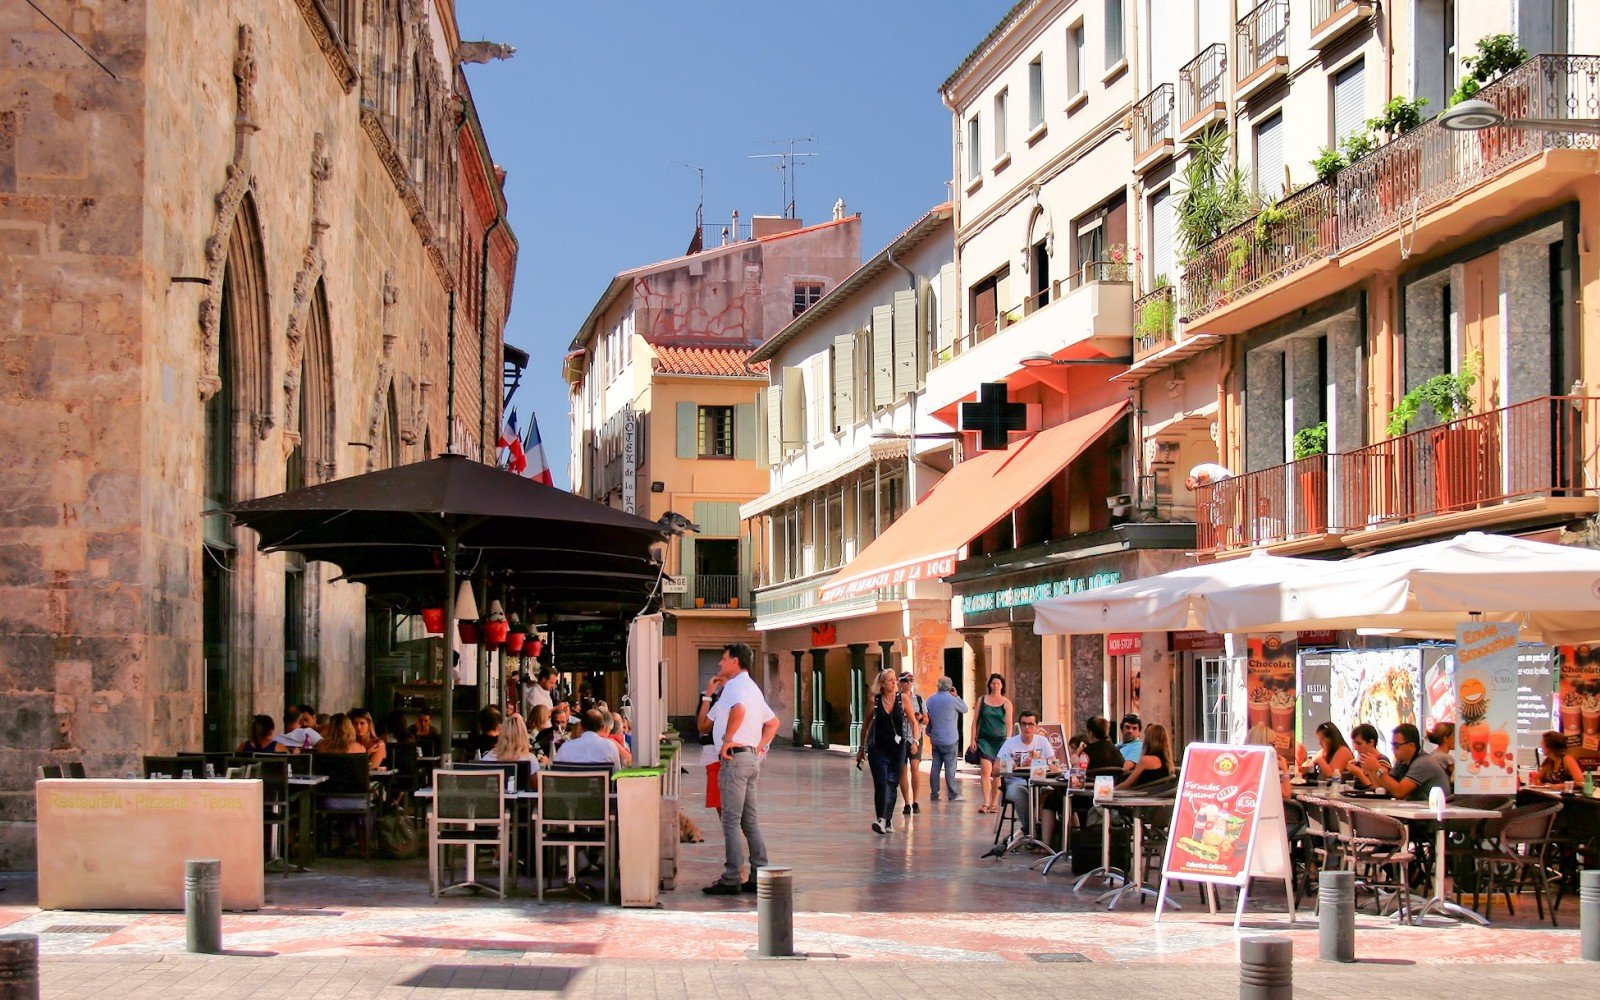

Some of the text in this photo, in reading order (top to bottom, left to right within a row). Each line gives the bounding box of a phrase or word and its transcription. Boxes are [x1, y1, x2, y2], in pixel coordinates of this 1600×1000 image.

[624, 412, 634, 464] HOTEL
[908, 565, 921, 579] LA
[1463, 625, 1497, 645] Envie
[1109, 639, 1133, 650] NON-STOP
[1249, 660, 1295, 669] Chocolats
[50, 793, 243, 811] Restaurant Pizzeria Tapas
